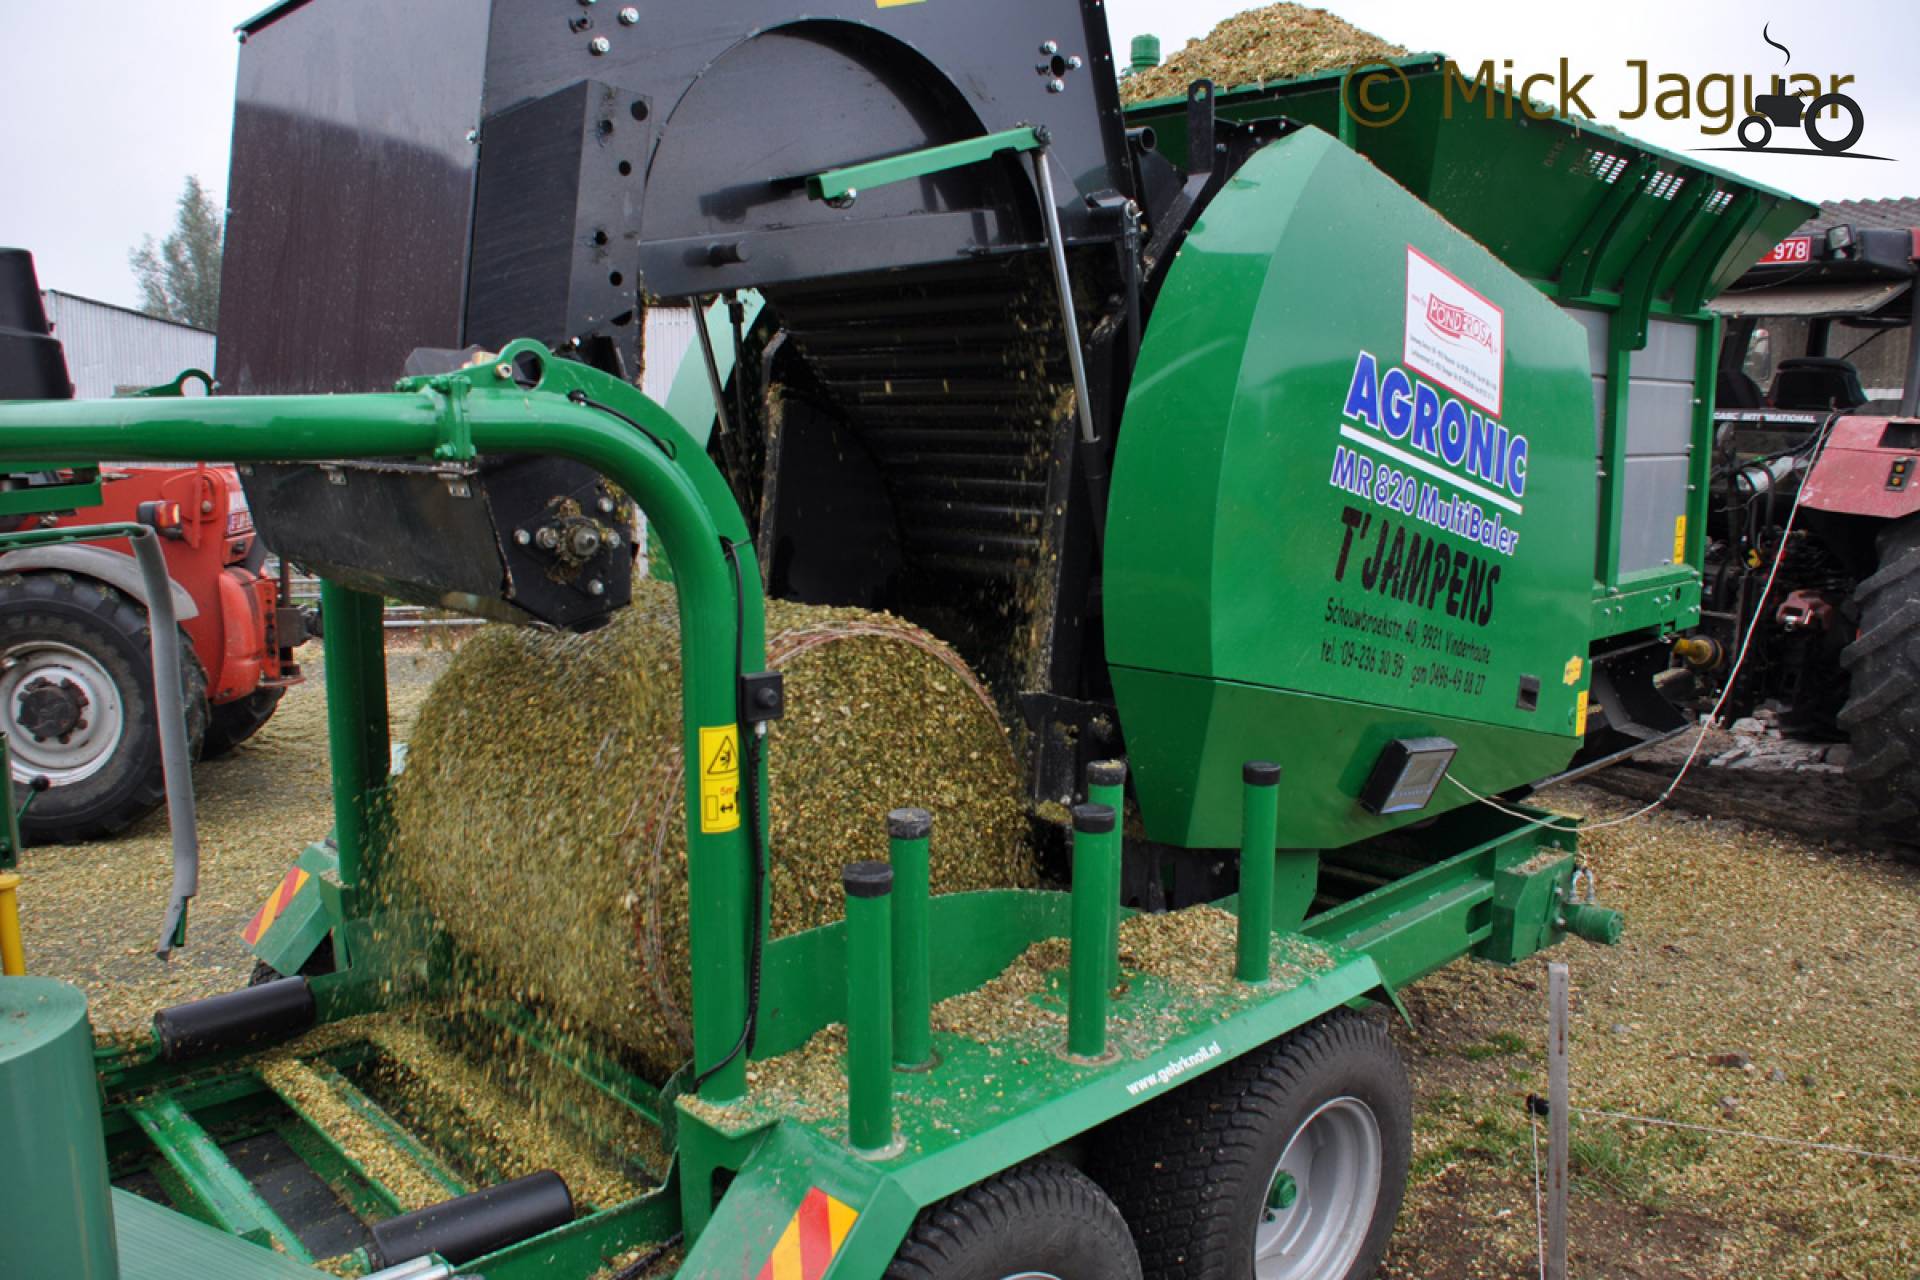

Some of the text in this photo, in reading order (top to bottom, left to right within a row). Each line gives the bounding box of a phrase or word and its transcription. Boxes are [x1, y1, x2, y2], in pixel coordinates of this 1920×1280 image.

[1774, 241, 1806, 260] 978
[1343, 350, 1528, 497] AGRONIC
[1330, 445, 1519, 556] MR 820 MultiBaler
